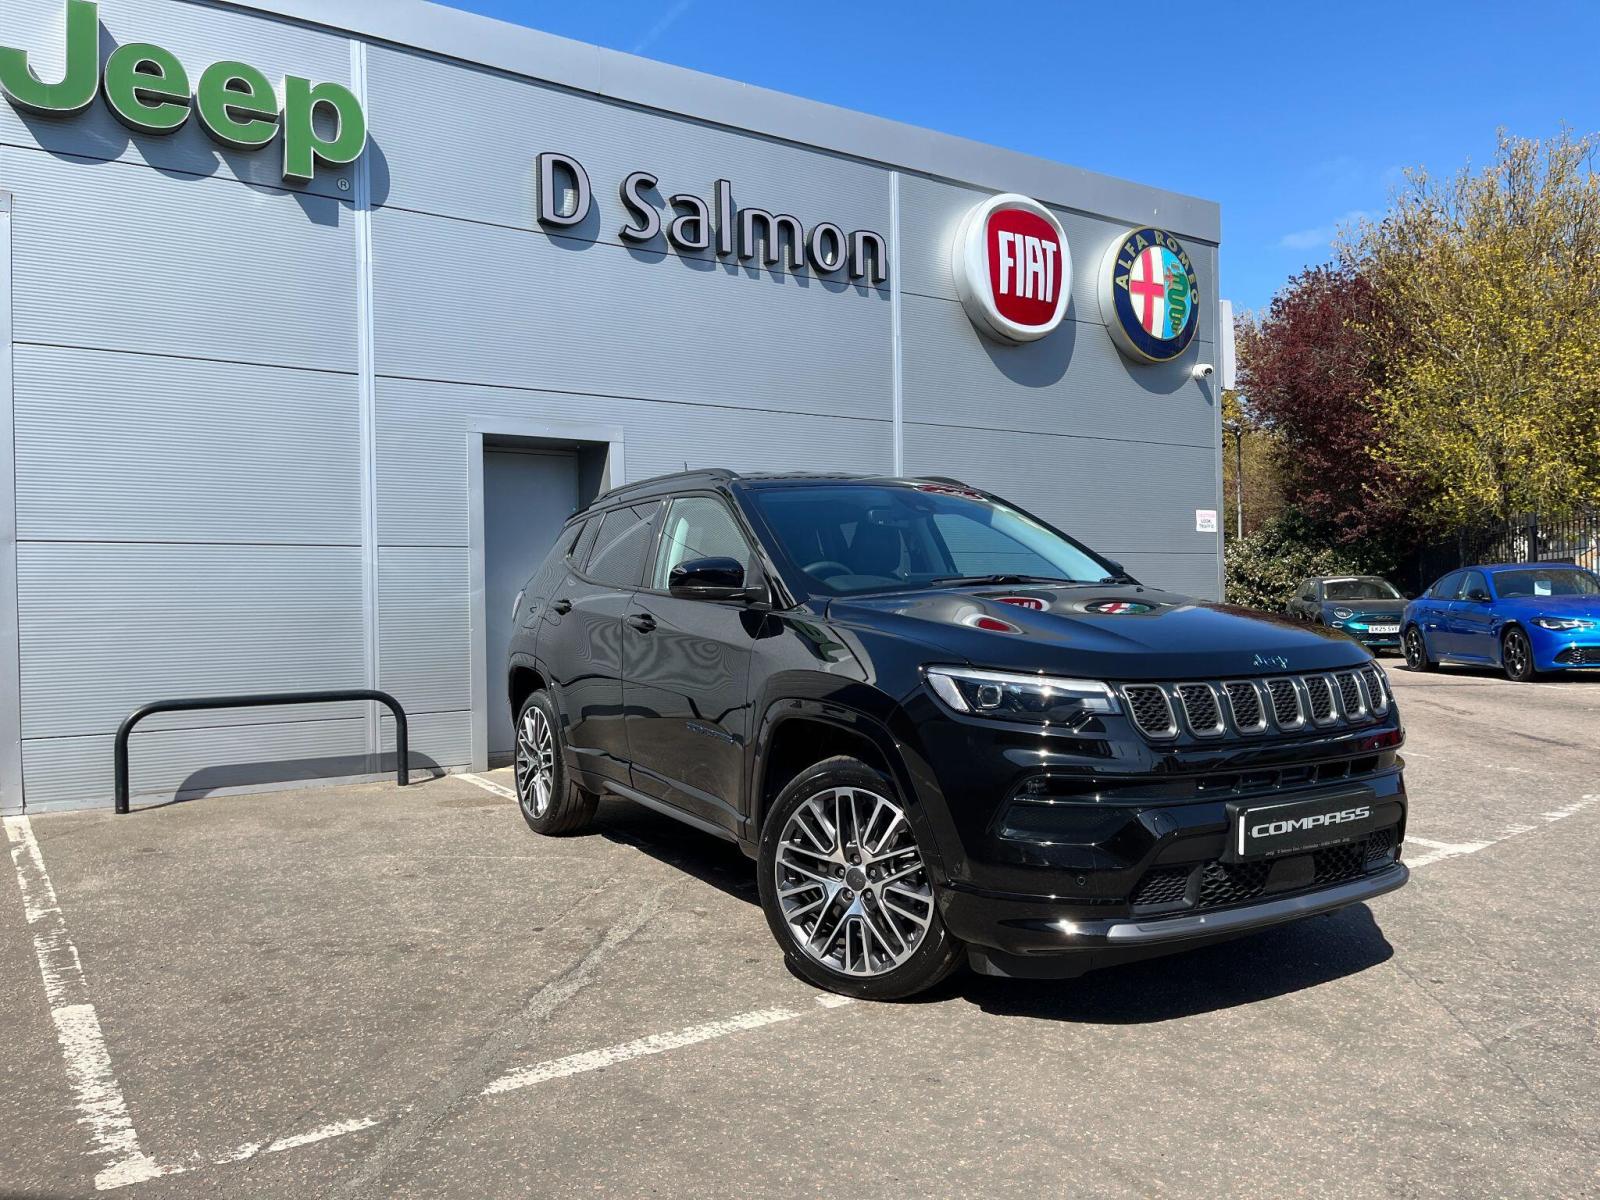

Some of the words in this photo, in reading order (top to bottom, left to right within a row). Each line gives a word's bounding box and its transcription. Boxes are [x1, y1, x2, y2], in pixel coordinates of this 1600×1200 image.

[0, 0, 367, 181] Jeep
[536, 152, 592, 227] D
[618, 171, 887, 283] Salmon
[998, 230, 1057, 303] FIAT
[1115, 233, 1150, 291] ALFA
[1154, 230, 1200, 305] ROMEO
[1251, 805, 1370, 838] COMPASS
